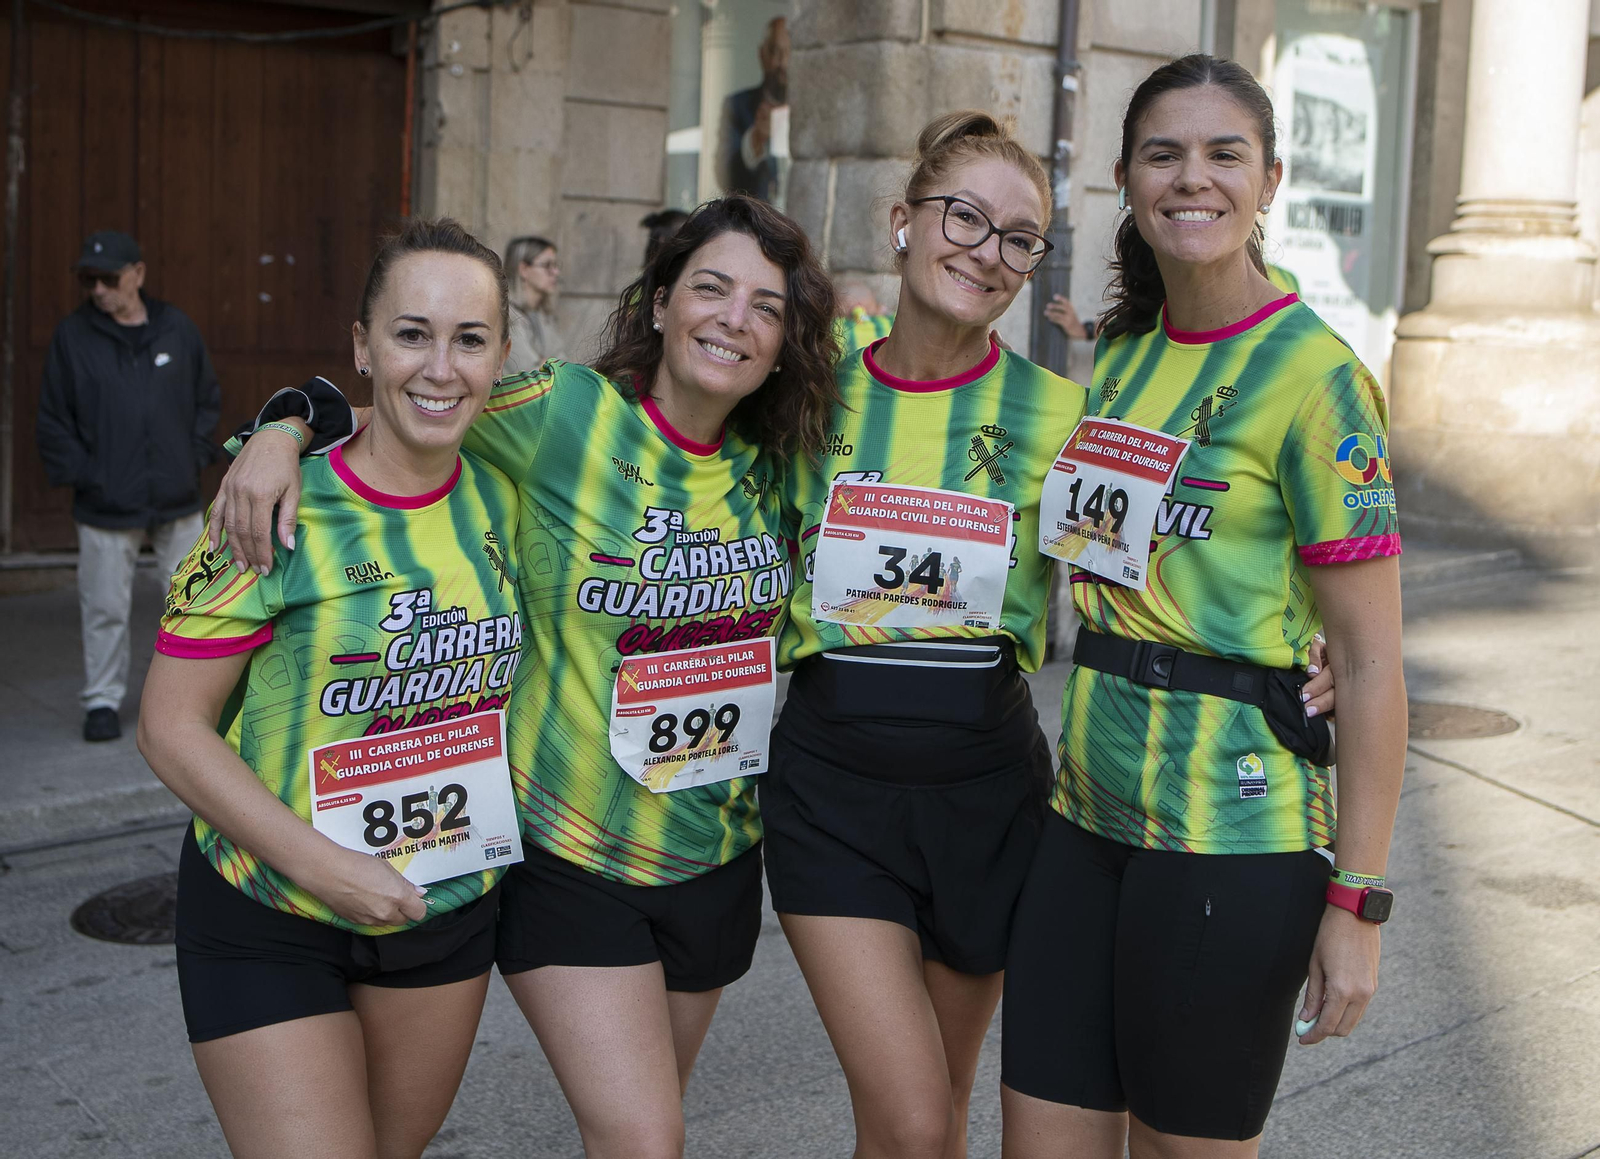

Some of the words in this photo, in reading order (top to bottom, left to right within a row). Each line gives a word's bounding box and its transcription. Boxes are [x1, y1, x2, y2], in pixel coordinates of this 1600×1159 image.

[825, 433, 844, 445] UN
[1089, 428, 1098, 437] III
[1098, 430, 1126, 444] CARRERA
[1127, 436, 1142, 448] DEL
[1142, 441, 1169, 456] PILAR
[1076, 442, 1102, 455] GUARDIA
[1102, 446, 1121, 459] CIVIL
[1121, 451, 1132, 462] DE
[1132, 454, 1172, 473] OURENSE
[848, 506, 898, 520] GUARDIA
[901, 511, 929, 524] CIVIL
[932, 516, 946, 526] DE
[949, 517, 1000, 535] OURENSE
[864, 493, 875, 502] III
[880, 494, 931, 509] CARRERA
[933, 499, 954, 512] DEL
[956, 504, 988, 518] PILAR
[1065, 477, 1129, 534] 149
[1155, 501, 1213, 539] VIL
[632, 506, 684, 544] 3ª
[674, 528, 720, 544] EDICIÓN
[1056, 520, 1081, 537] ESTEFANIA
[1082, 528, 1097, 542] ELENA
[1098, 533, 1111, 546] PEÑA
[1112, 538, 1130, 553] QUINTAS
[344, 560, 382, 582] RUN
[639, 533, 782, 581] CARRERA
[874, 545, 944, 594] 34
[380, 588, 432, 632] 3ª
[578, 575, 745, 619] GUARDIA
[846, 588, 882, 601] PATRICIA
[884, 594, 920, 606] PAREDES
[922, 598, 968, 610] RODRIGUEZ
[422, 607, 467, 629] EDICIÓN
[386, 612, 522, 671] CARRERA
[637, 678, 683, 692] GUARDIA
[685, 674, 710, 685] CIVIL
[712, 670, 724, 681] DE
[726, 664, 766, 678] OURENSE
[647, 664, 658, 674] III
[663, 657, 708, 672] CARRERA
[709, 655, 726, 666] DEL
[728, 650, 754, 663] PILAR
[320, 659, 484, 717] GUARDIA
[350, 750, 362, 761] III
[368, 738, 422, 757] CARRERA
[424, 733, 446, 746] DEL
[448, 724, 480, 741] PILAR
[649, 703, 741, 754] 899
[336, 760, 392, 780] GUARDIA
[394, 754, 424, 768] CIVIL
[427, 750, 442, 762] DE
[443, 736, 495, 758] OURENSE
[643, 753, 687, 766] ALEXANDRA
[688, 749, 717, 762] PORTELA
[718, 744, 739, 755] LORES
[318, 800, 340, 808] ABSOLUTA
[362, 783, 471, 848] 852
[371, 847, 403, 860] ORENA
[404, 844, 421, 856] DEL
[422, 840, 436, 850] RIO
[438, 831, 470, 846] MARTIN
